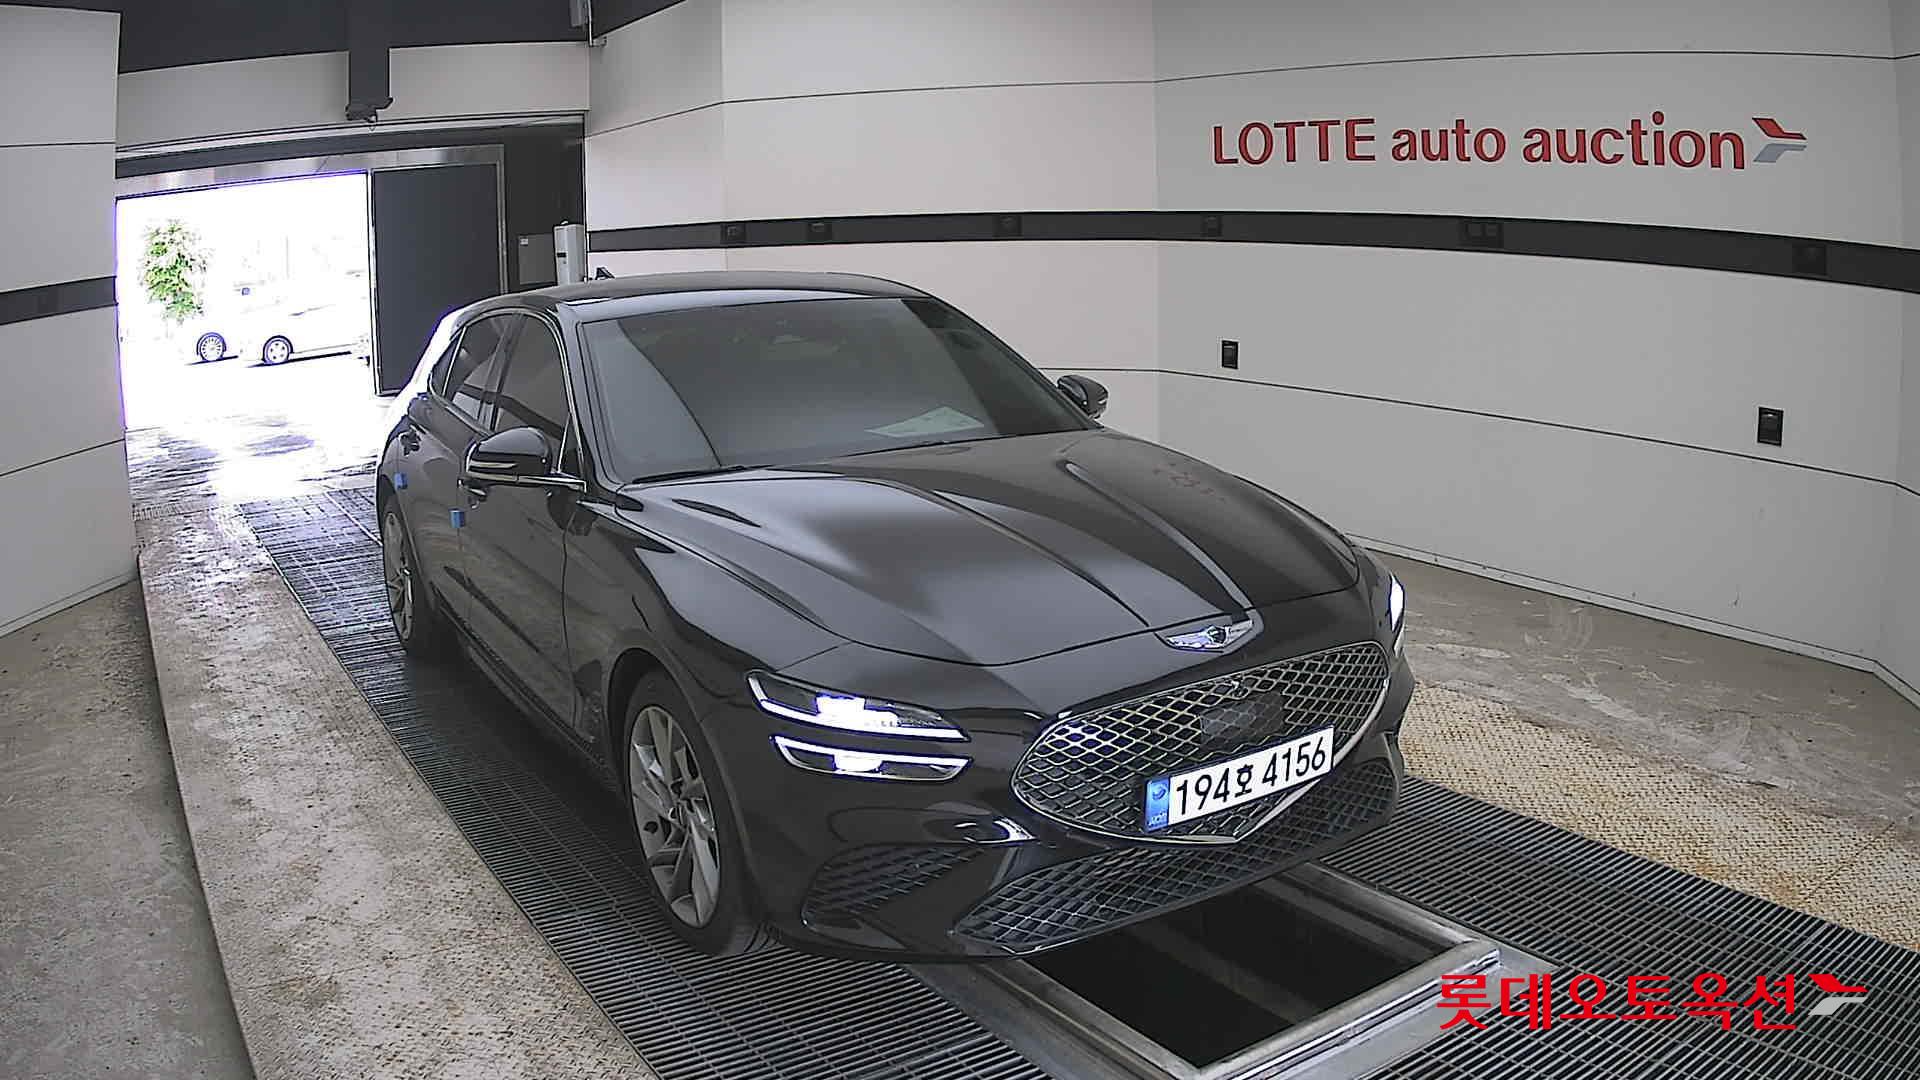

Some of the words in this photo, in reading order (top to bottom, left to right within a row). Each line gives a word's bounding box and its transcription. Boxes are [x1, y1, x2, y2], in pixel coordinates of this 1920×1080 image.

[1213, 118, 1376, 165] LOTTE
[1391, 119, 1506, 163] auto
[1522, 111, 1746, 170] auction
[1176, 764, 1254, 815] 194호
[1262, 736, 1326, 787] 4156
